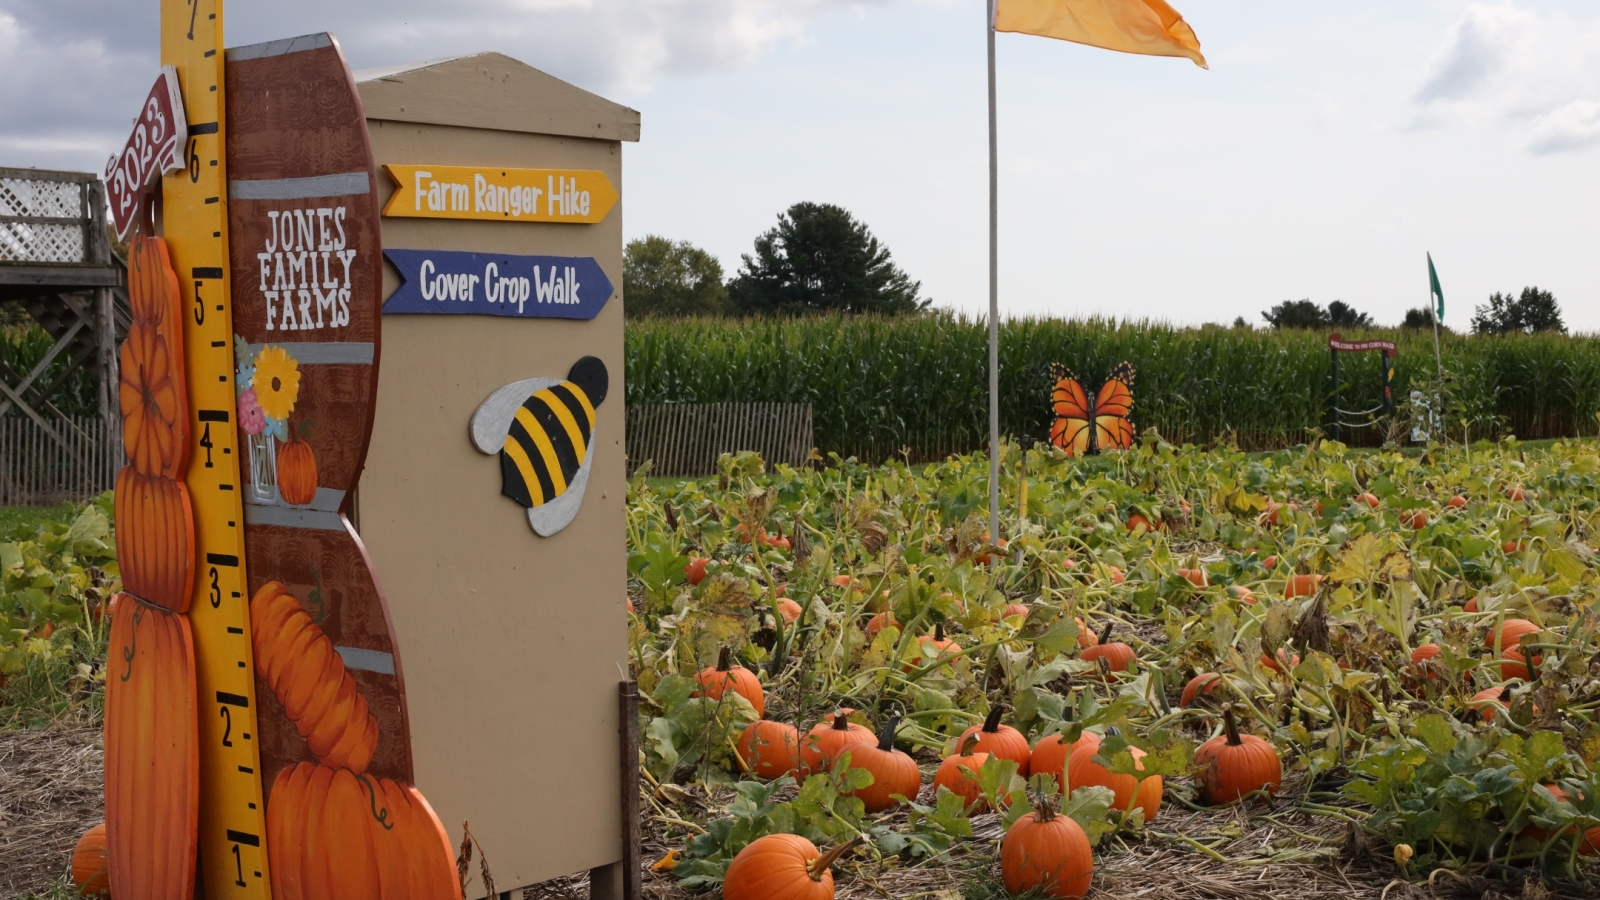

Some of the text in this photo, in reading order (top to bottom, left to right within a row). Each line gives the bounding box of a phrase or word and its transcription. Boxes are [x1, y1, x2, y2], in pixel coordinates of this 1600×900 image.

[113, 96, 165, 218] 2023
[189, 139, 200, 184] 6
[414, 171, 591, 217] Farm Ranger Hike
[265, 207, 346, 253] JONES
[257, 250, 356, 291] FAMILY
[420, 259, 581, 314] Cover Crop Walk
[194, 280, 205, 326] 5
[264, 288, 351, 331] FARMS
[1330, 340, 1354, 350] WELCOME
[1382, 341, 1395, 349] MAZE
[199, 422, 214, 468] 4
[209, 567, 221, 609] 3
[221, 706, 233, 748] 2
[231, 844, 247, 888] 1
